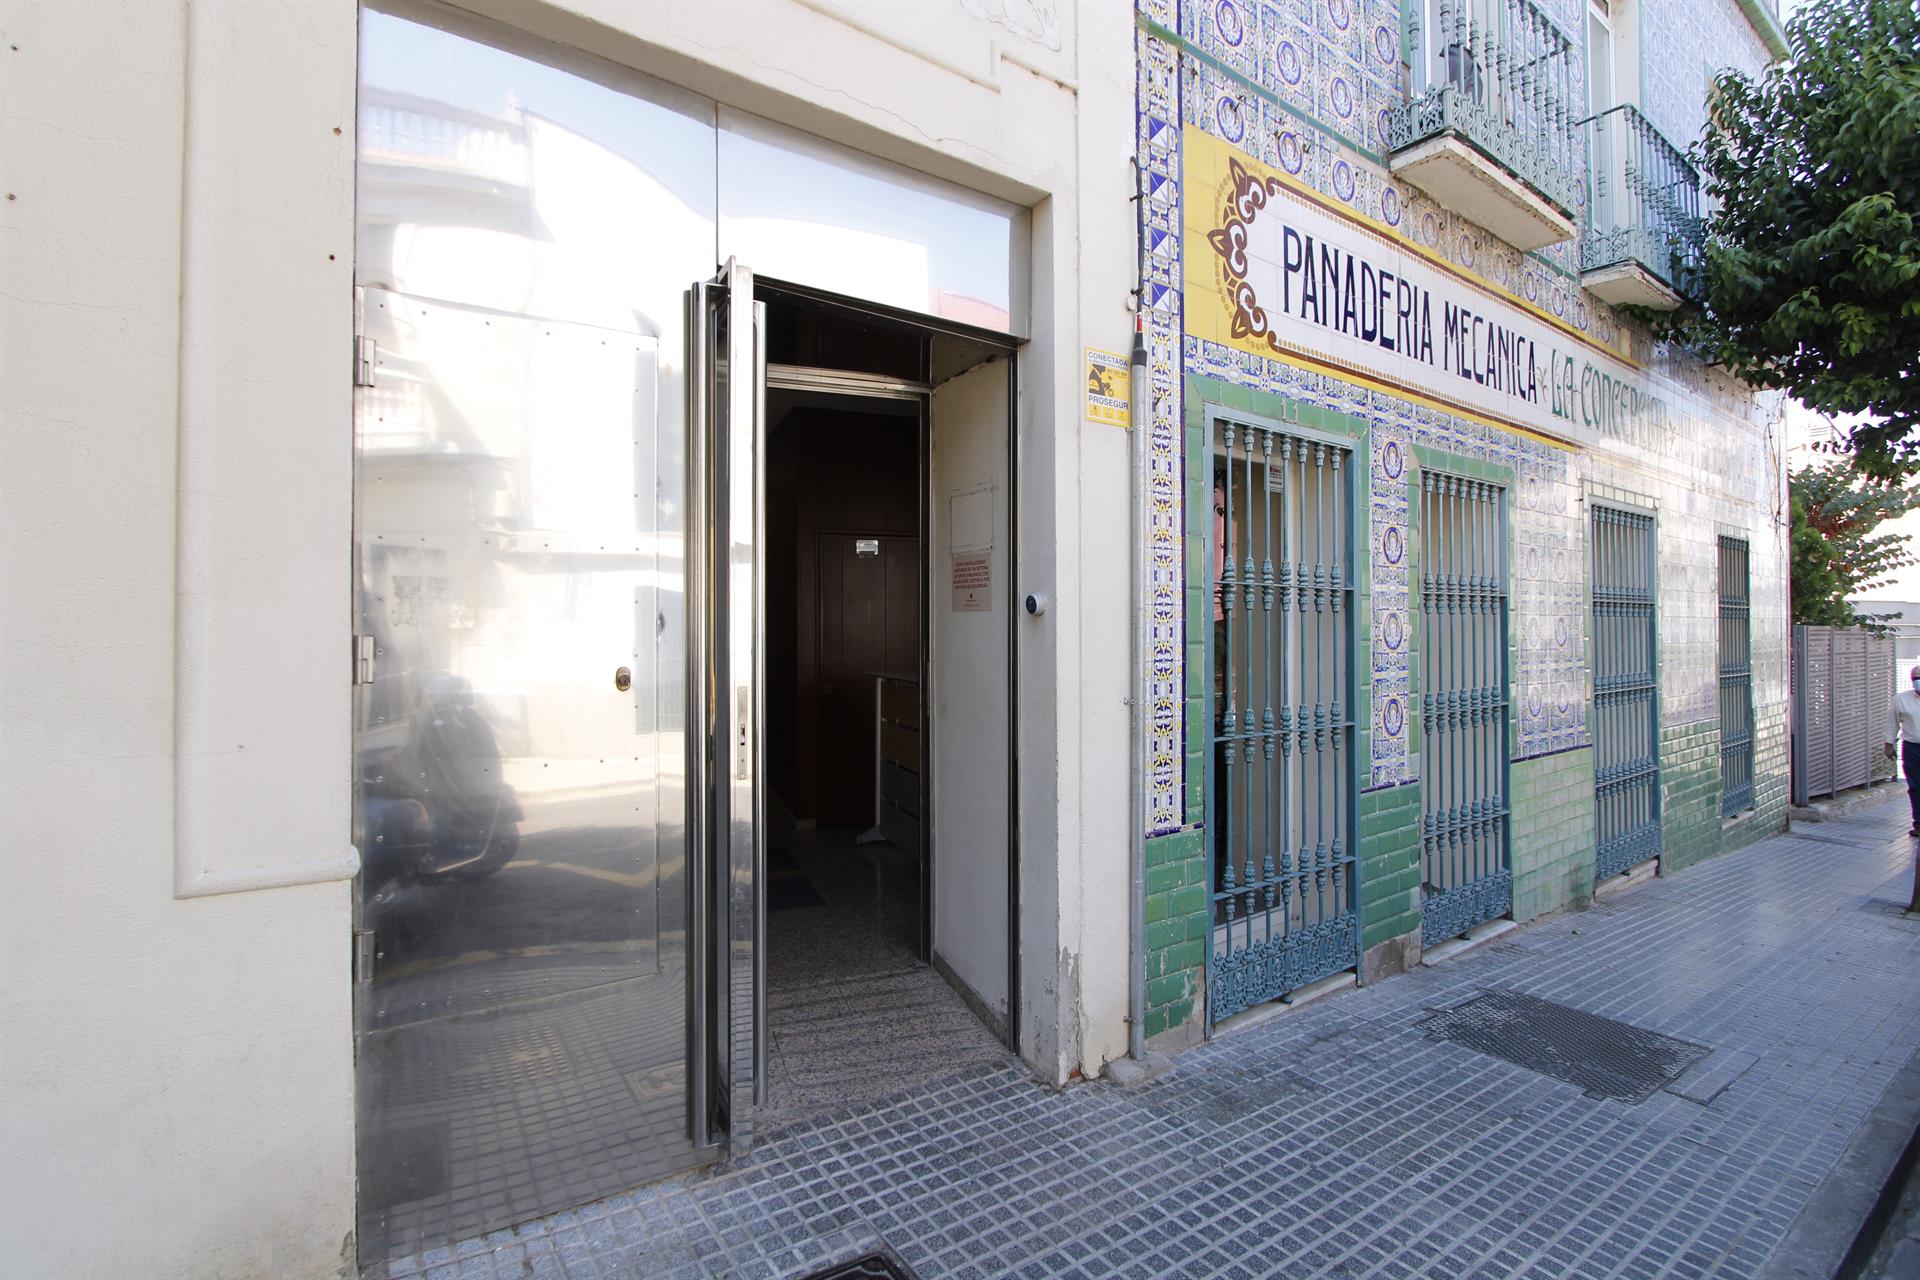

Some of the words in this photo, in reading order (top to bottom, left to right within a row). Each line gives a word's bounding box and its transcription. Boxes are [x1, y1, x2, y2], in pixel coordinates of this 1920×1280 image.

[1283, 225, 1434, 366] PANADERIA
[1444, 300, 1538, 405] MECANICA
[1088, 351, 1129, 367] CONECTADA
[1088, 394, 1129, 410] PROSEGUR
